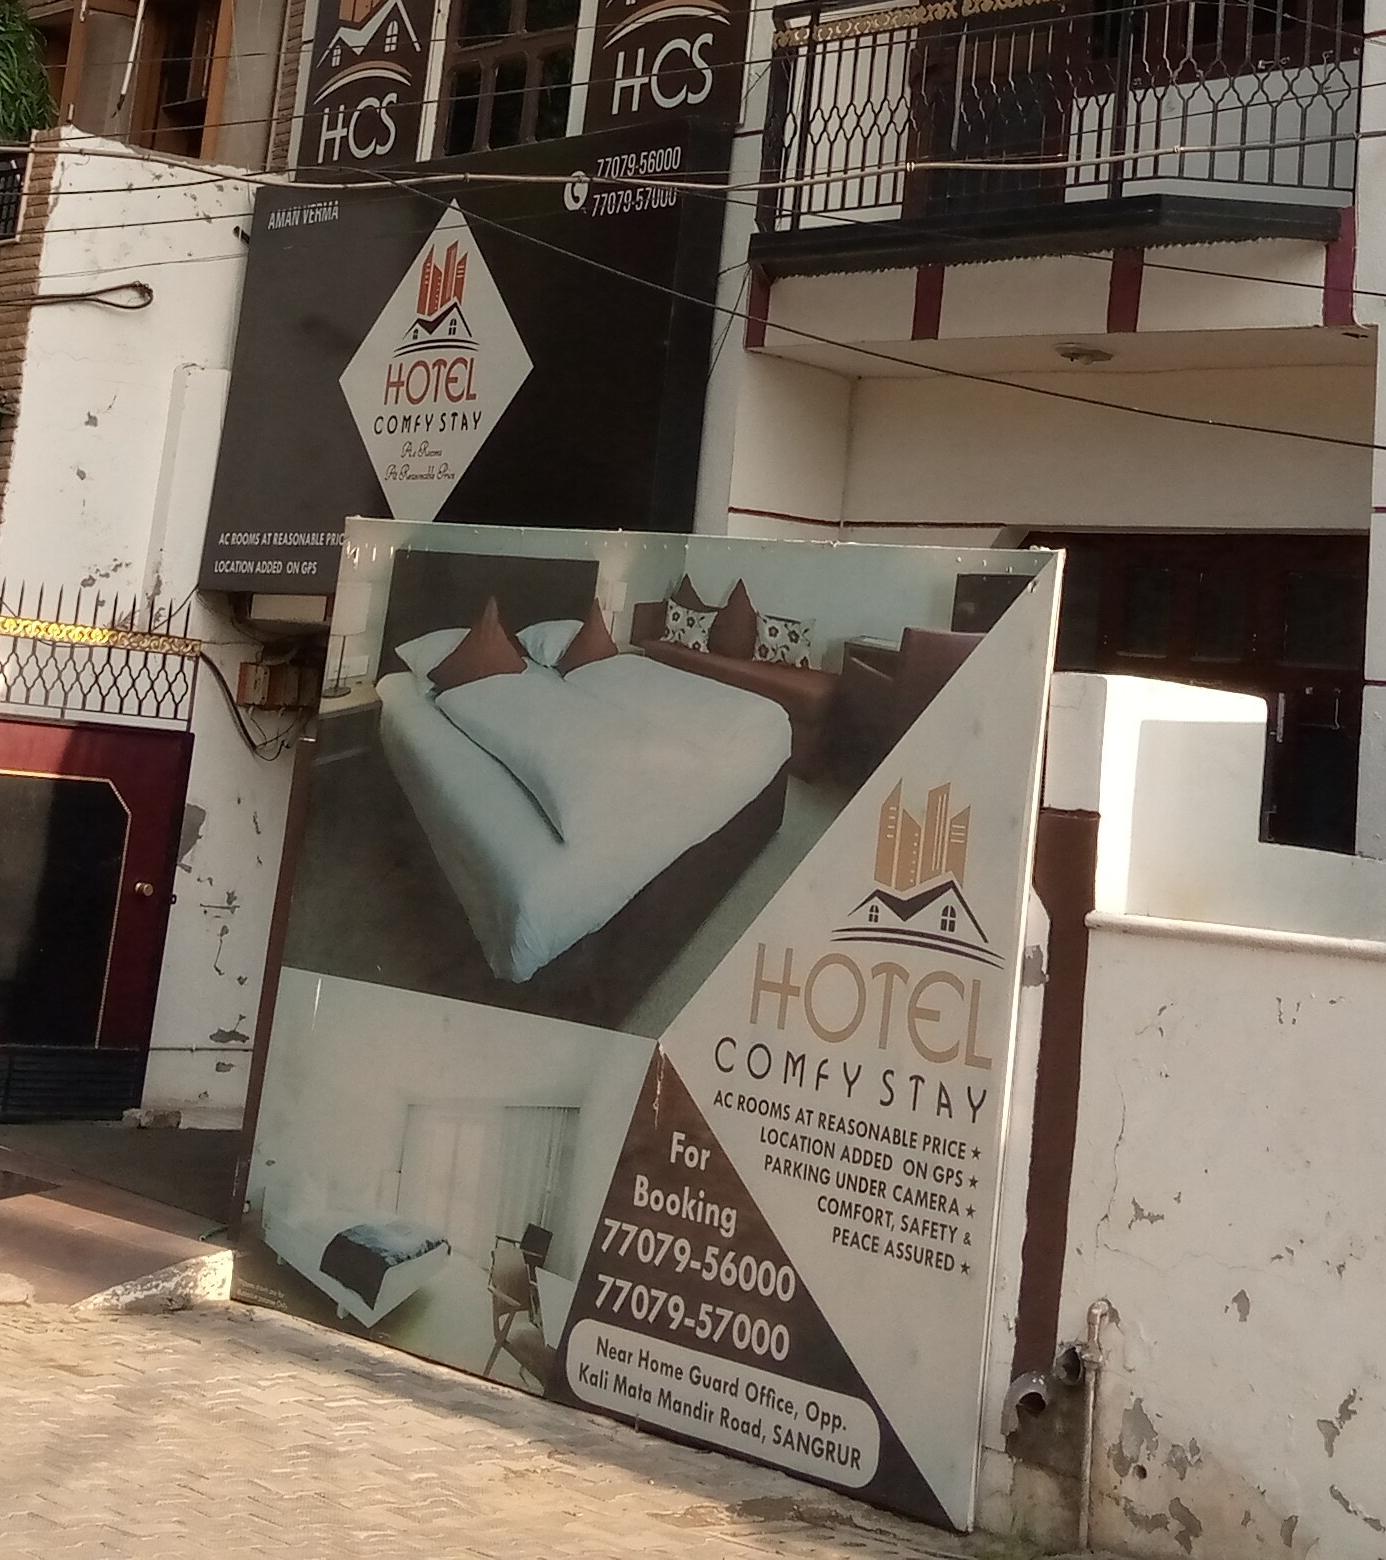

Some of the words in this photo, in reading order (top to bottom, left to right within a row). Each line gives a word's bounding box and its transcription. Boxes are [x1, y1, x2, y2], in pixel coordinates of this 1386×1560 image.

[611, 32, 714, 116] HCS
[317, 91, 397, 164] HCS
[596, 146, 682, 178] 77079-56000
[267, 208, 300, 230] AMAN
[302, 200, 339, 224] VERMA
[591, 187, 678, 217] 77079-57000
[384, 357, 477, 406] HOTEL
[373, 413, 434, 435] COMFY
[439, 410, 482, 432] STAY
[214, 560, 254, 573] LOCATION
[255, 560, 283, 574] ADDED
[286, 561, 300, 574] ON
[301, 561, 318, 575] GPS
[218, 532, 231, 545] AC
[232, 532, 260, 545] ROOMS
[261, 532, 272, 545] AT
[273, 532, 324, 546] REASONABLE
[325, 532, 344, 546] PRIC
[749, 942, 993, 1071] HOTEL
[714, 1037, 862, 1098] COMFY
[879, 1069, 988, 1124] STAY
[669, 1131, 711, 1171] For
[714, 1090, 733, 1108] AC
[737, 1094, 791, 1121] ROOMS
[795, 1107, 814, 1126] AT
[817, 1111, 918, 1149] REASONABLE
[922, 1134, 967, 1160] PRICE
[760, 1126, 835, 1159] LOCATION
[840, 1145, 893, 1172] ADDED
[902, 1158, 928, 1180] ON
[932, 1165, 964, 1188] GPS
[764, 1155, 831, 1186] PARKING
[835, 1171, 887, 1199] UNDER
[892, 1185, 960, 1217] CAMERA
[633, 1174, 738, 1239] Booking
[817, 1195, 895, 1232] COMFORT,
[900, 1214, 959, 1244] SAFETY
[963, 1231, 972, 1246] &
[601, 1217, 797, 1303] 77079-56000
[832, 1226, 879, 1254] PEACE
[884, 1241, 955, 1272] ASSURED
[595, 1273, 791, 1362] 77079-57000
[596, 1336, 633, 1366] Near
[637, 1349, 684, 1381] Home
[689, 1365, 739, 1399] Guard
[745, 1382, 799, 1420] Office,
[805, 1401, 848, 1432] Opp.
[578, 1362, 609, 1391] Kali
[614, 1374, 652, 1405] Mata
[657, 1389, 714, 1424] Mandir
[719, 1408, 766, 1444] Road,
[772, 1425, 862, 1471] SANGRUR
